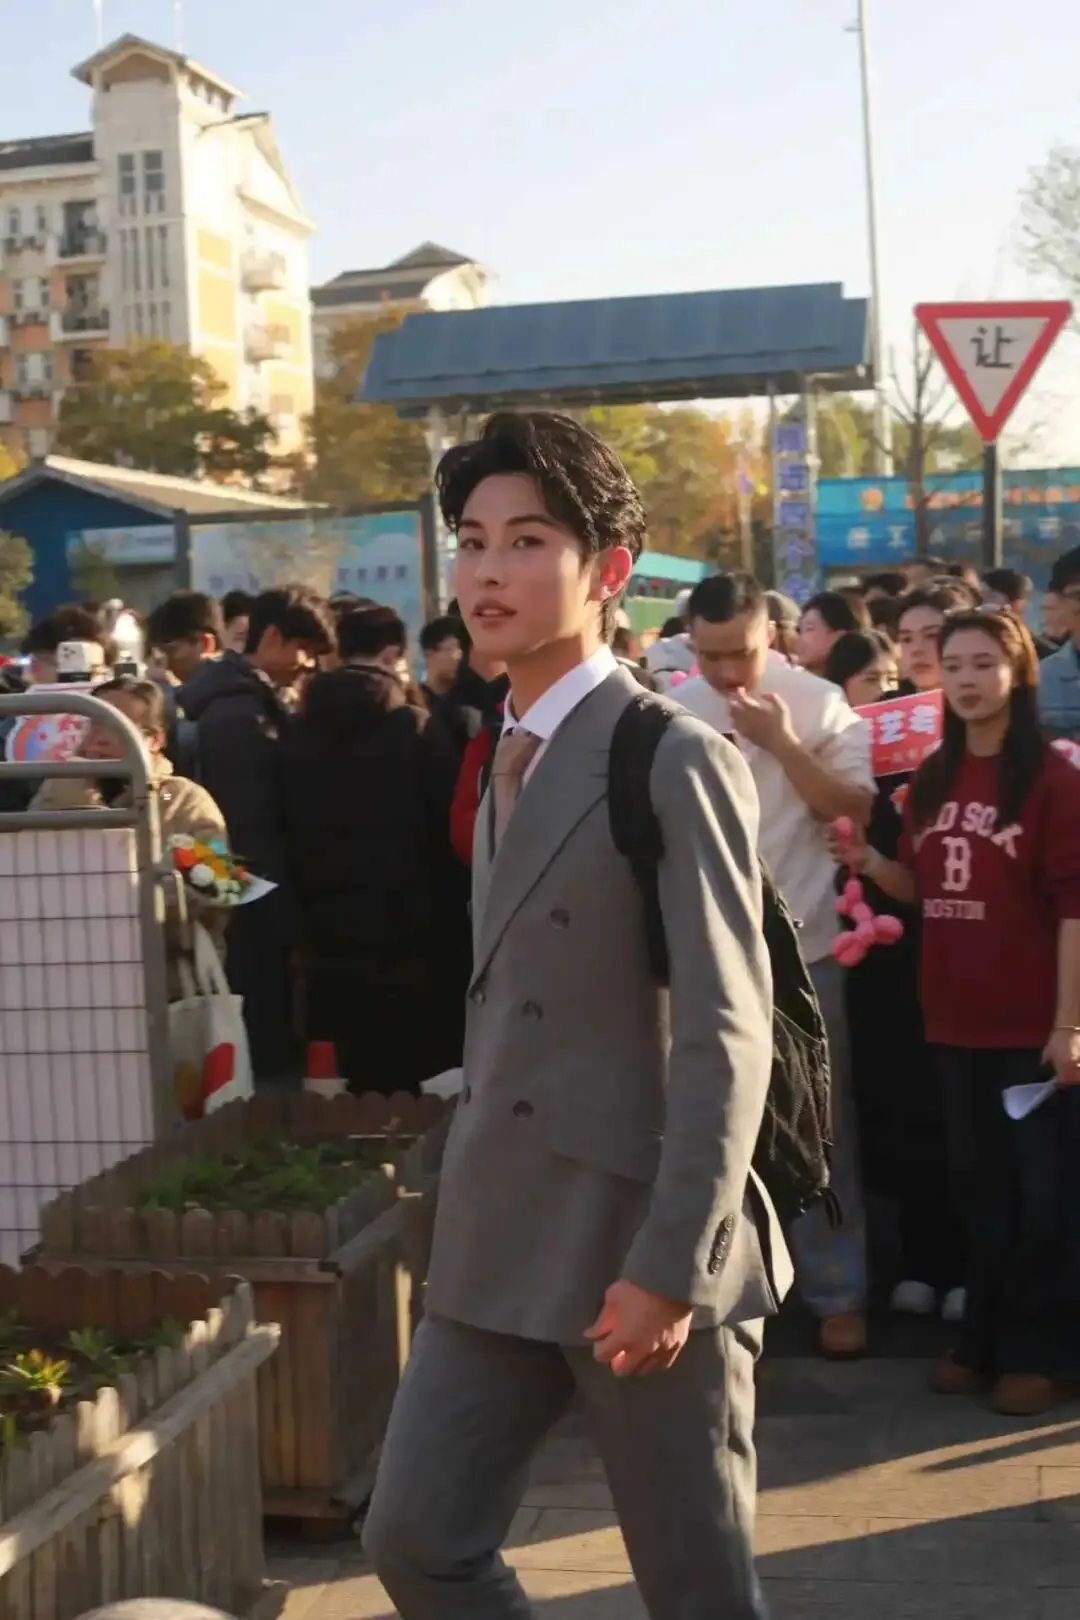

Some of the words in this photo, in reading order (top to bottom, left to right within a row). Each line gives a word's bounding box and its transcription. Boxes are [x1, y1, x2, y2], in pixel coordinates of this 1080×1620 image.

[969, 325, 1015, 369] 让
[868, 704, 938, 745] 艺考
[941, 836, 972, 891] B
